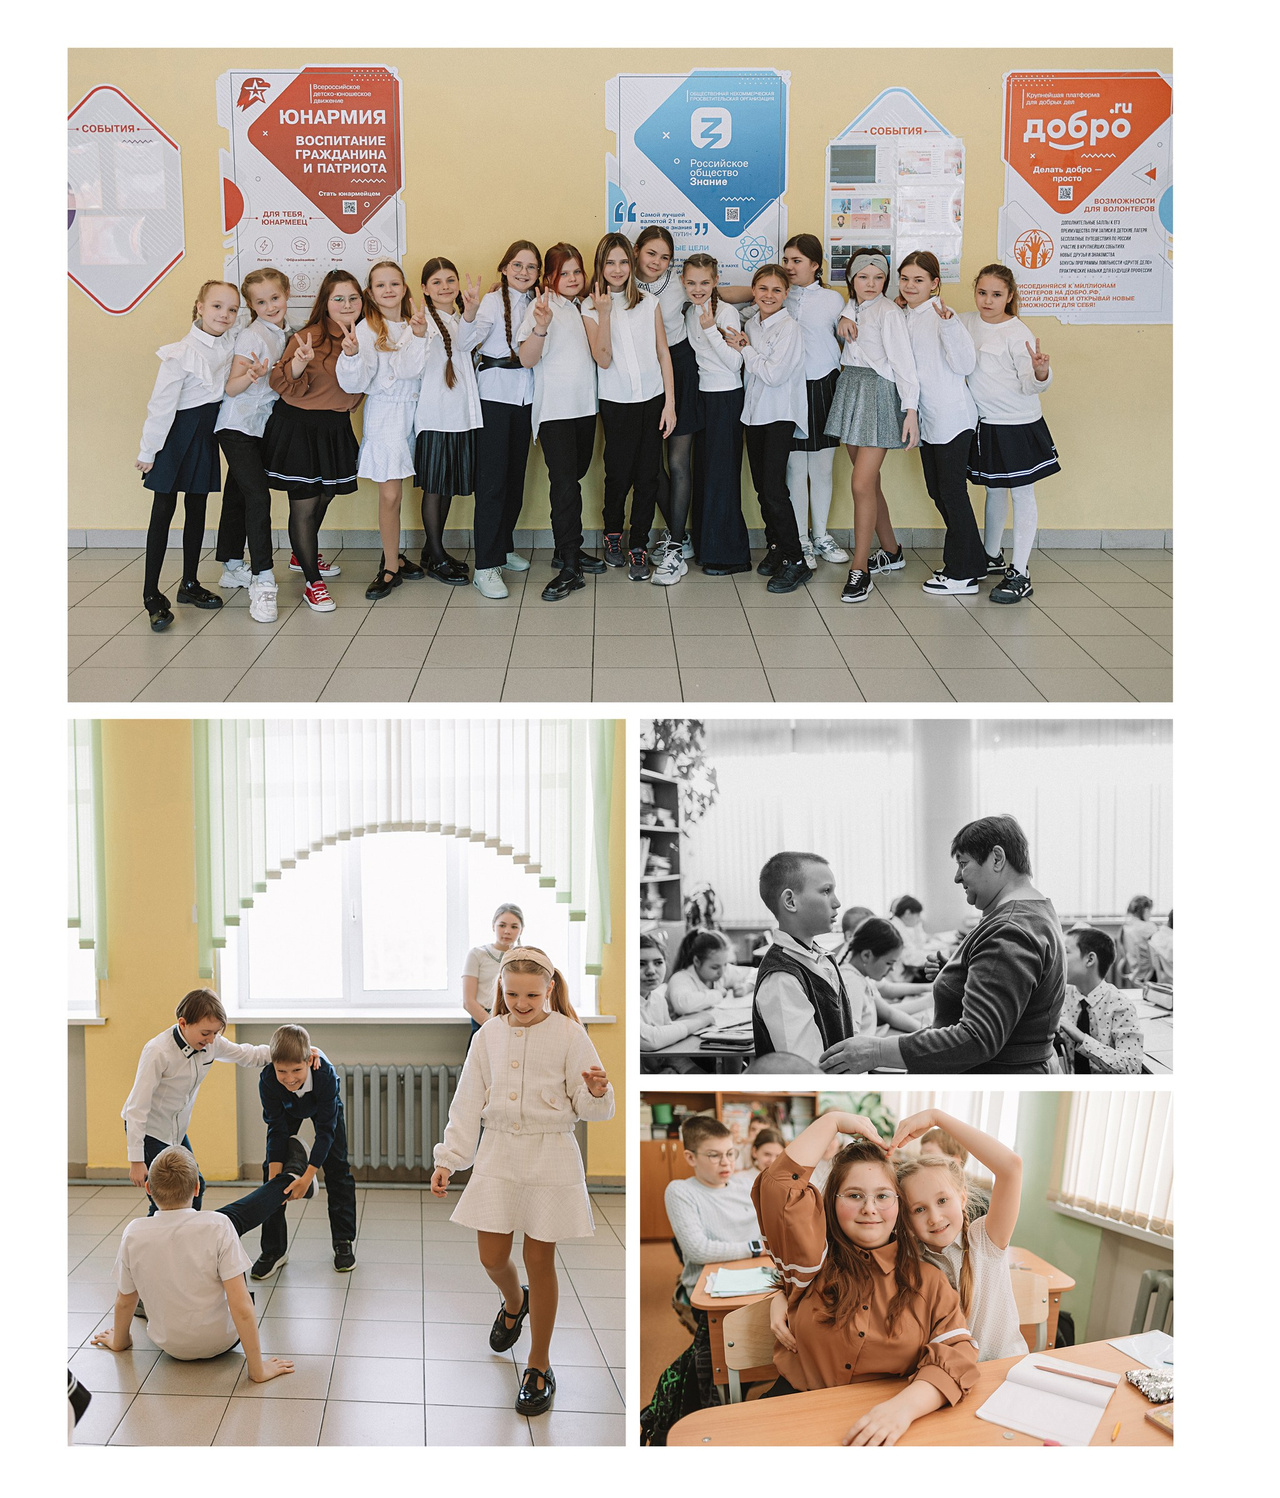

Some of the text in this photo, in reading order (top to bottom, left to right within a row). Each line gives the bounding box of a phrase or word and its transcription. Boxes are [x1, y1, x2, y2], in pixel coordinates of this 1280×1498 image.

[279, 109, 387, 125] ЮНАРМИЯ
[81, 124, 135, 133] СОБЫТИЯ
[870, 127, 923, 135] СОБЫТИЯ
[1023, 109, 1131, 146] добро
[295, 135, 387, 146] ВОСПИТАНИЕ
[295, 149, 387, 162] ГРАЖДАНИНА
[303, 163, 388, 173] И ПАТРИОТА
[690, 159, 749, 168] Российское
[690, 168, 739, 178] общество
[1032, 165, 1093, 175] Делать добро
[690, 177, 728, 186] Знание
[338, 190, 381, 198] юнармейцем
[1084, 205, 1101, 213] ДЛЯ
[282, 211, 305, 219] ТЕБЯ,
[689, 244, 710, 252] ЦЕЛИ
